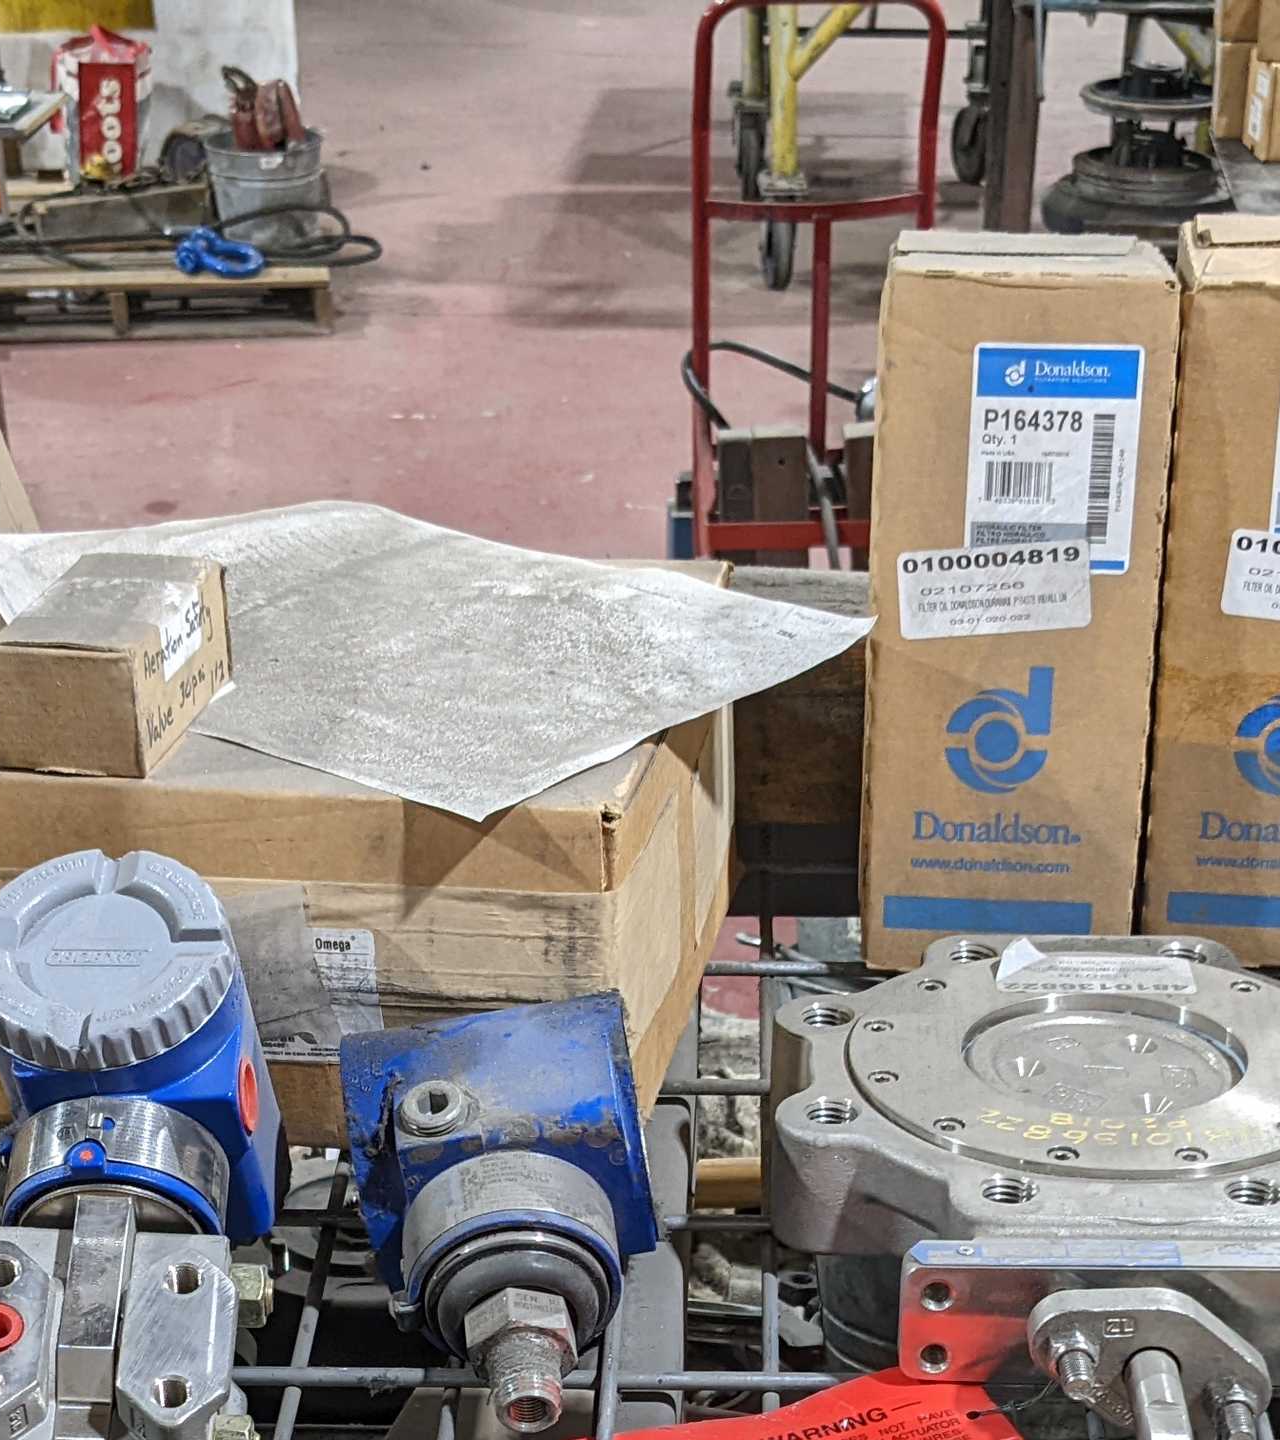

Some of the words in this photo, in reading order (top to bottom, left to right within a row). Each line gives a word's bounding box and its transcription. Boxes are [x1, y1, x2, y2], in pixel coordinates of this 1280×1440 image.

[983, 409, 1083, 432] P164378
[982, 434, 1006, 446] Qty.
[1010, 434, 1017, 445] 1
[903, 546, 1080, 574] 0100004819
[146, 705, 175, 748] Valve
[910, 856, 1071, 874] www.donaldson.com
[315, 938, 351, 952] Omega
[878, 1421, 906, 1436] NOT
